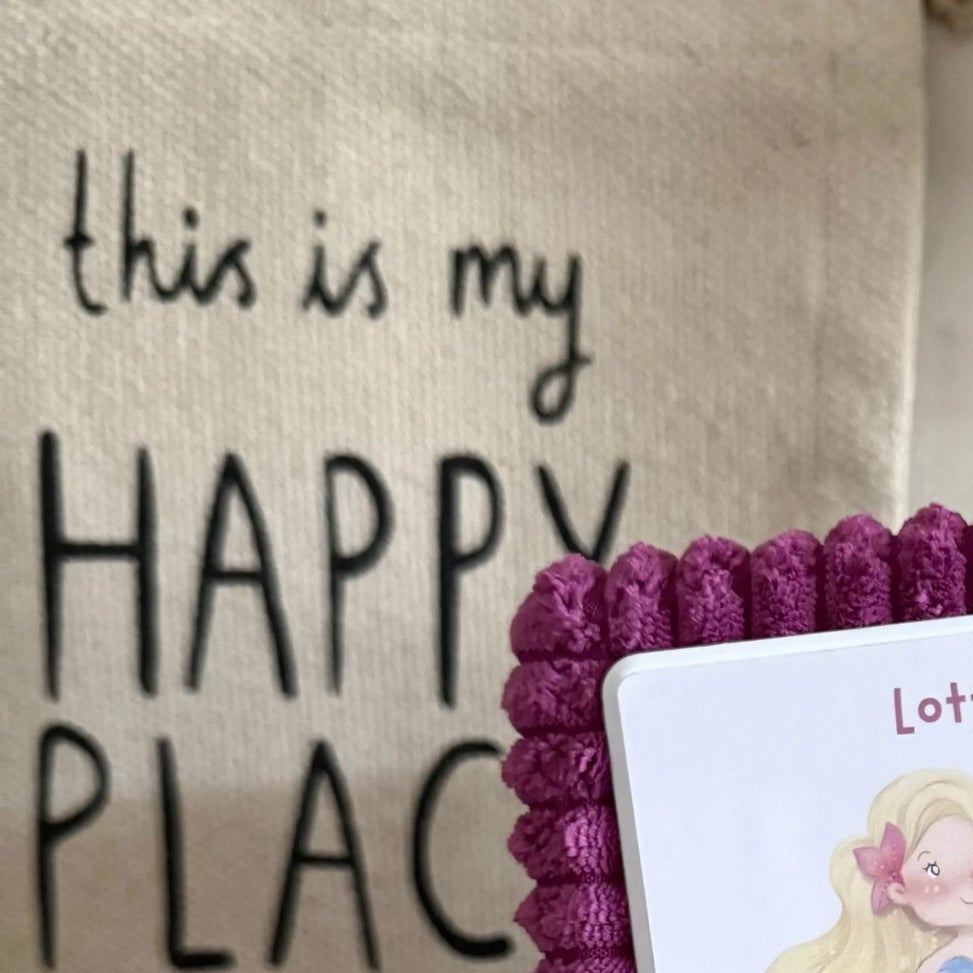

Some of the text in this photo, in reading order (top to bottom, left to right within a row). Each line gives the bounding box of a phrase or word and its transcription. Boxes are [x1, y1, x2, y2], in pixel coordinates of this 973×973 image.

[63, 149, 591, 424] this is my
